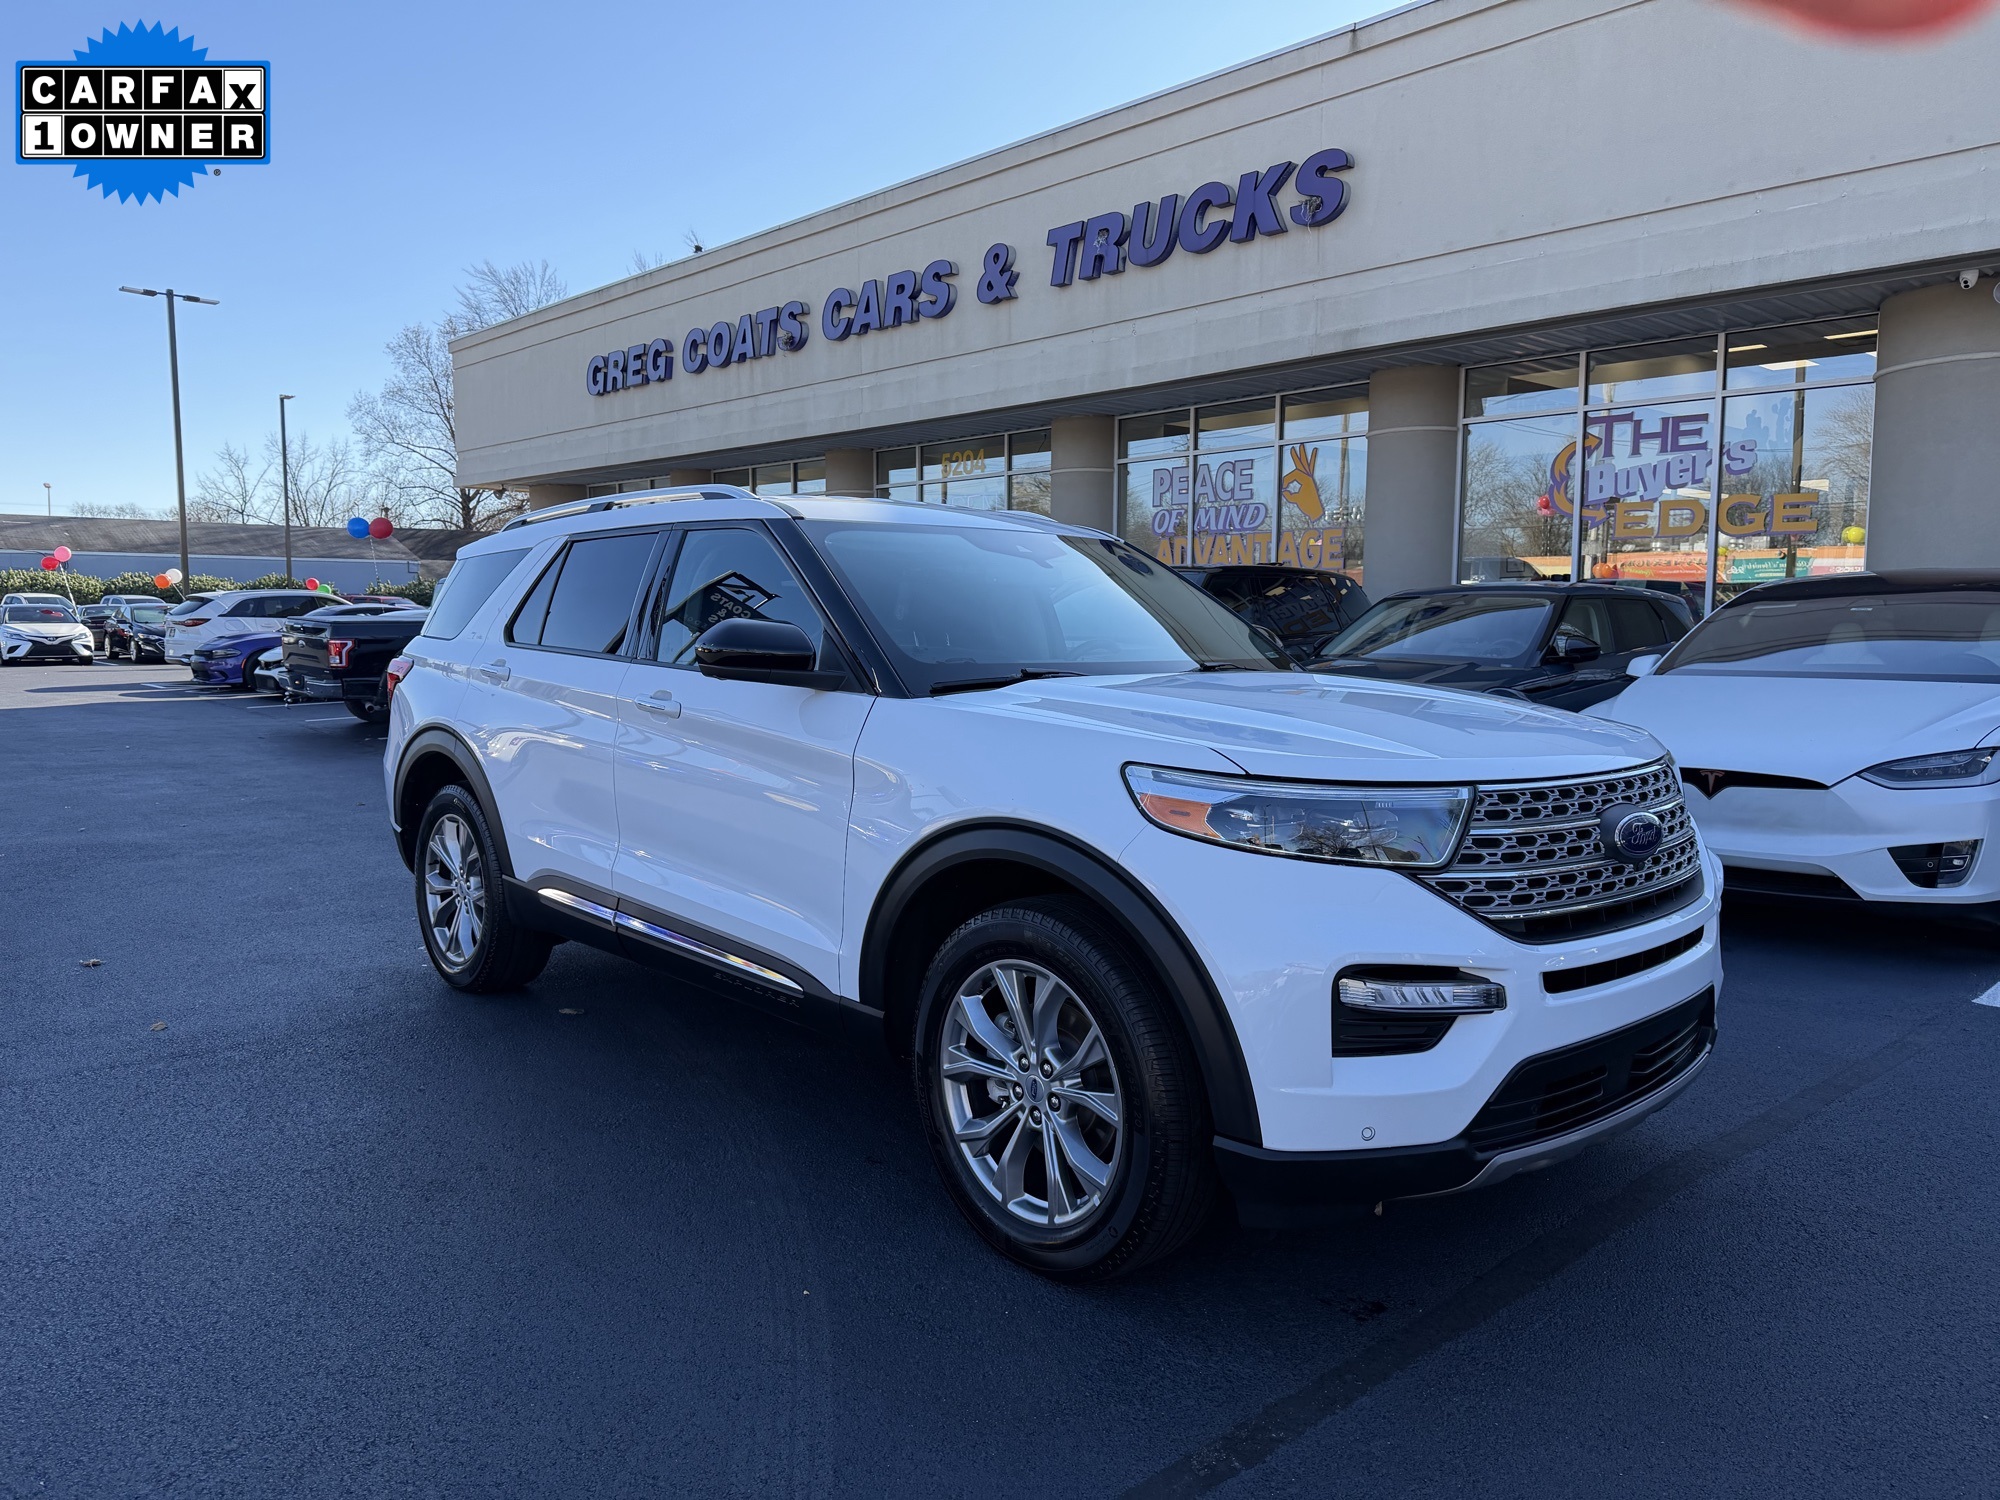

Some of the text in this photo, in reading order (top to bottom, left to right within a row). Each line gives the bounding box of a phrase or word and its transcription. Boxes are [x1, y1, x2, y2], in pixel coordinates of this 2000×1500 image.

[586, 147, 1355, 397] GREG COATS CARS & TRUCKS
[1587, 411, 1709, 458] THE
[940, 448, 987, 479] 5204
[1152, 458, 1255, 508] PEACE
[1152, 501, 1268, 536] OF MIND
[1612, 491, 1821, 541] EDGE
[1156, 527, 1347, 570] ADVANTAGE
[1632, 822, 1657, 844] Ford
